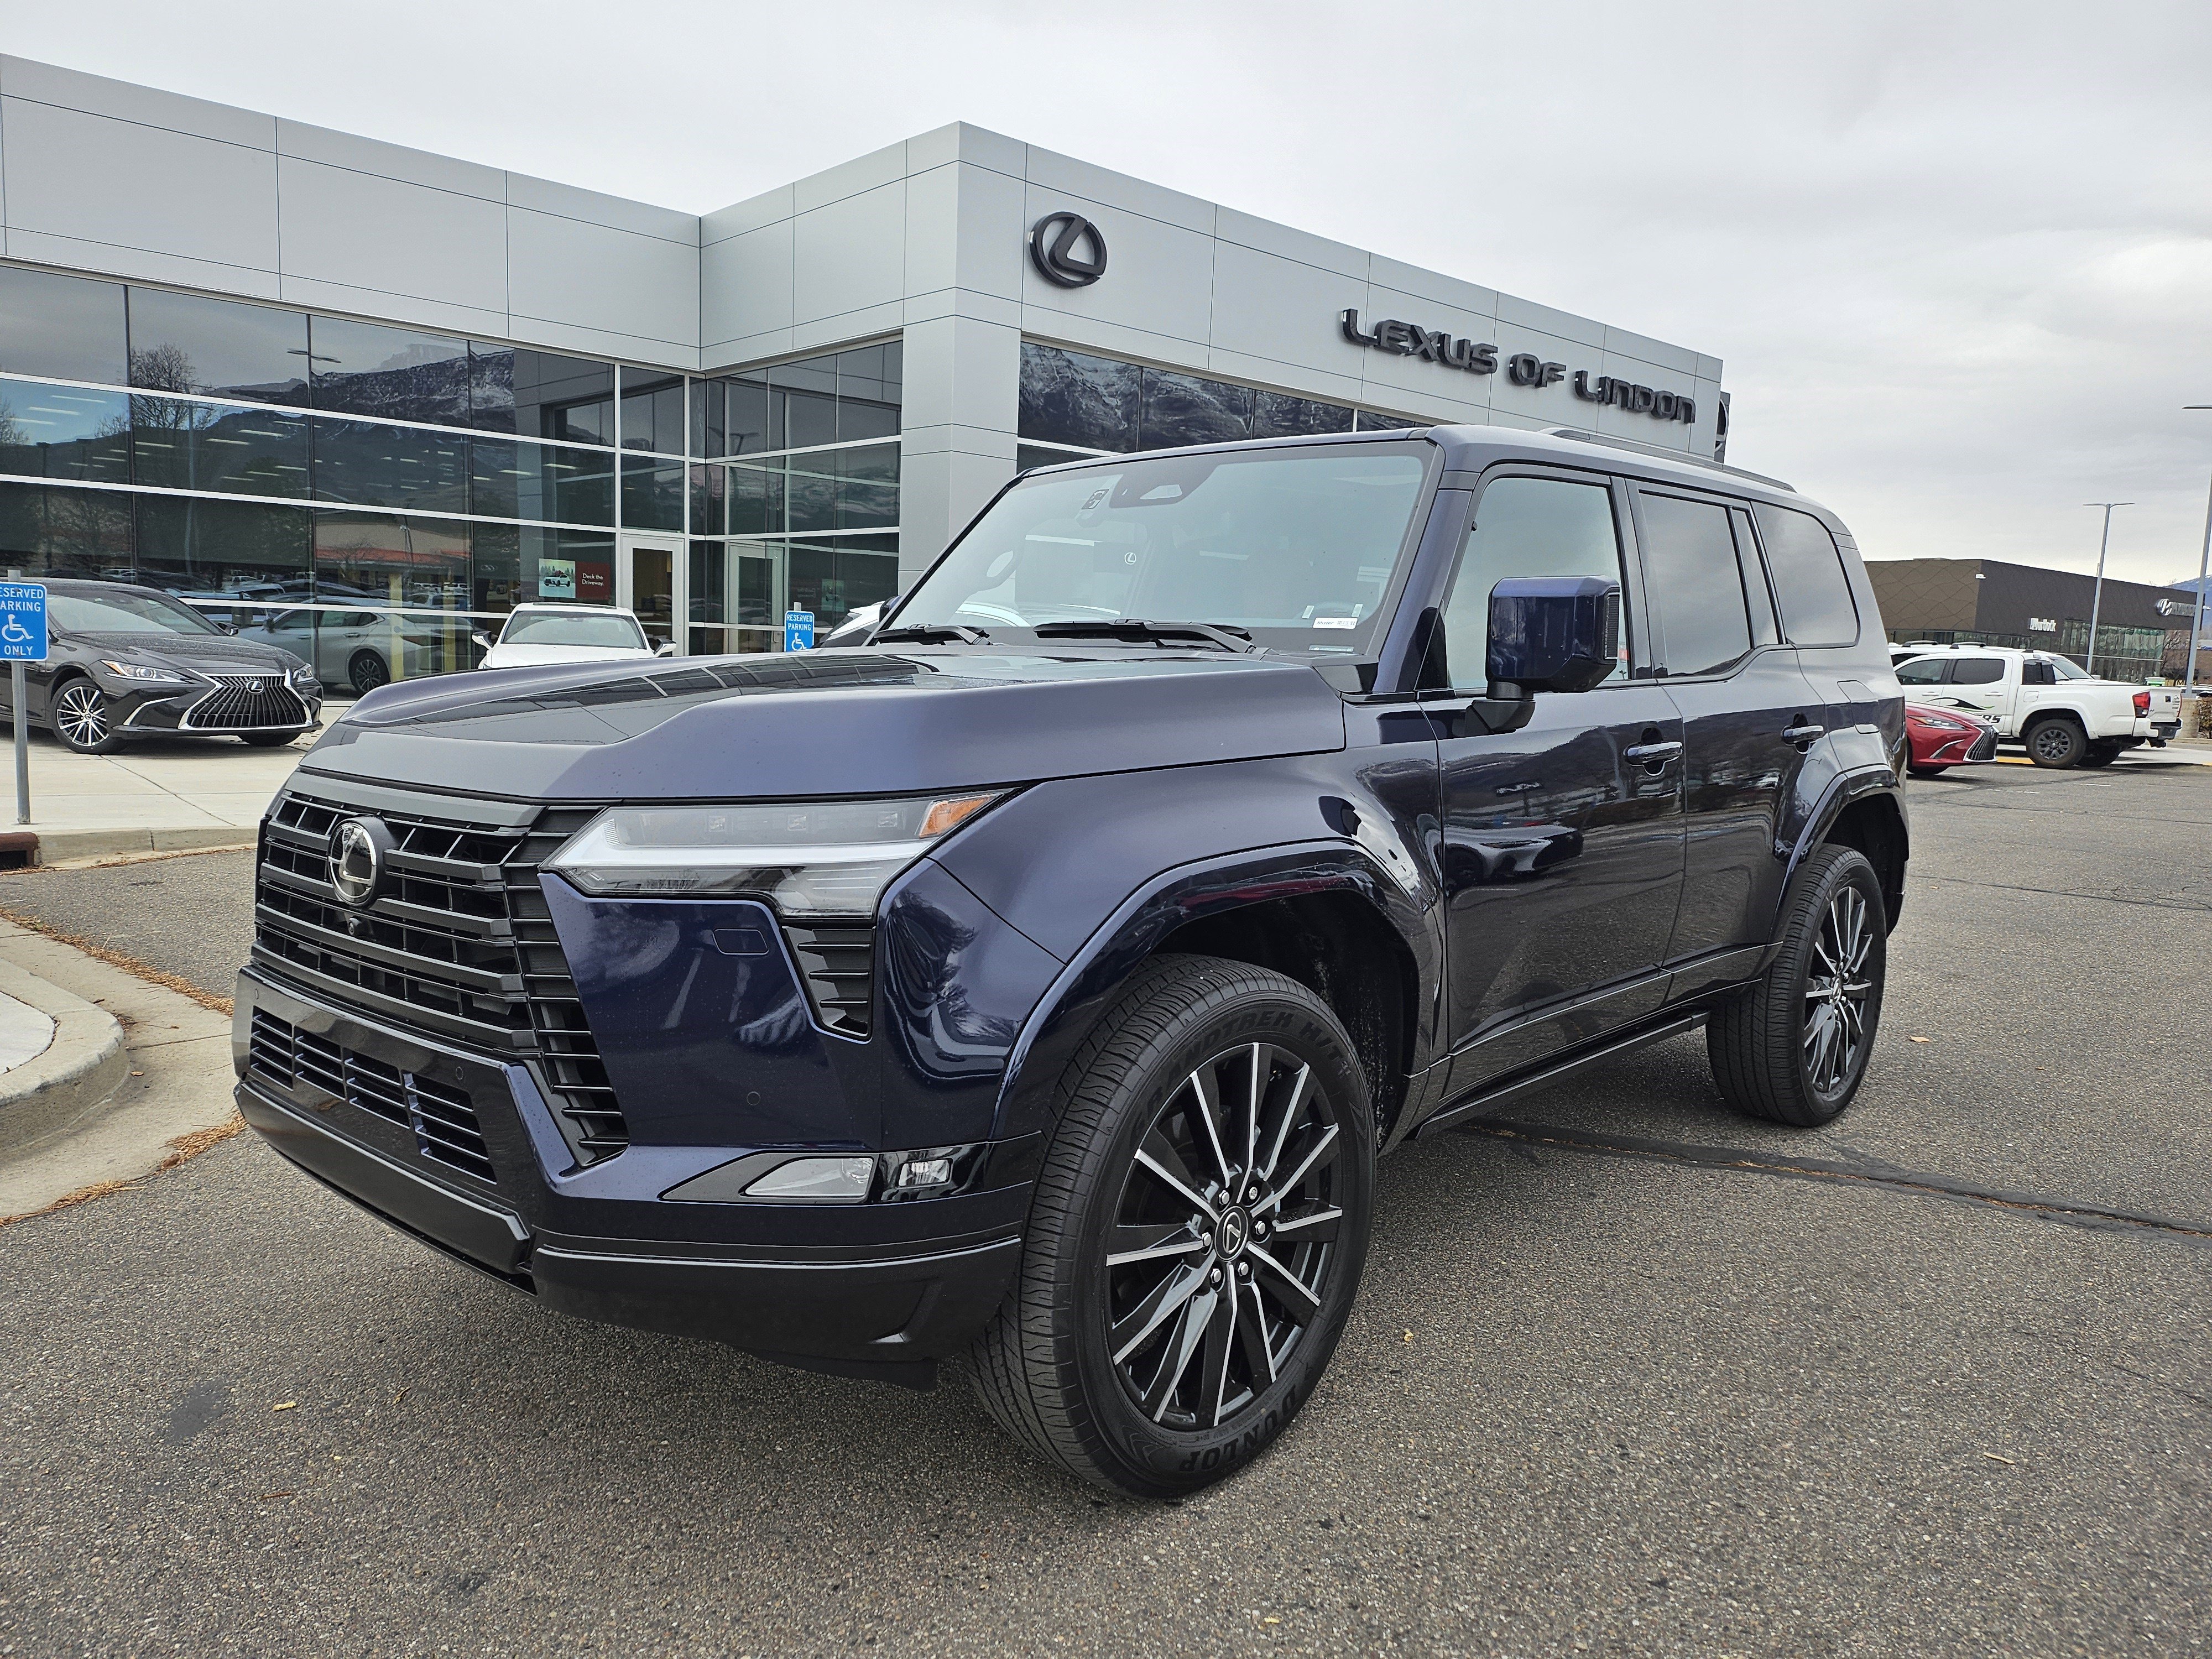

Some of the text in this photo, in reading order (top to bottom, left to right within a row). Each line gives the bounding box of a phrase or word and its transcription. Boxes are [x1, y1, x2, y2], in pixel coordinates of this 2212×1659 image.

[1342, 308, 1696, 424] LEXUS OF LINDON
[0, 600, 41, 612] ARKING
[786, 614, 813, 622] RESERVED
[787, 623, 811, 631] PARKING
[4, 645, 33, 656] ONLY
[1178, 1384, 1297, 1473] DUNLOP
